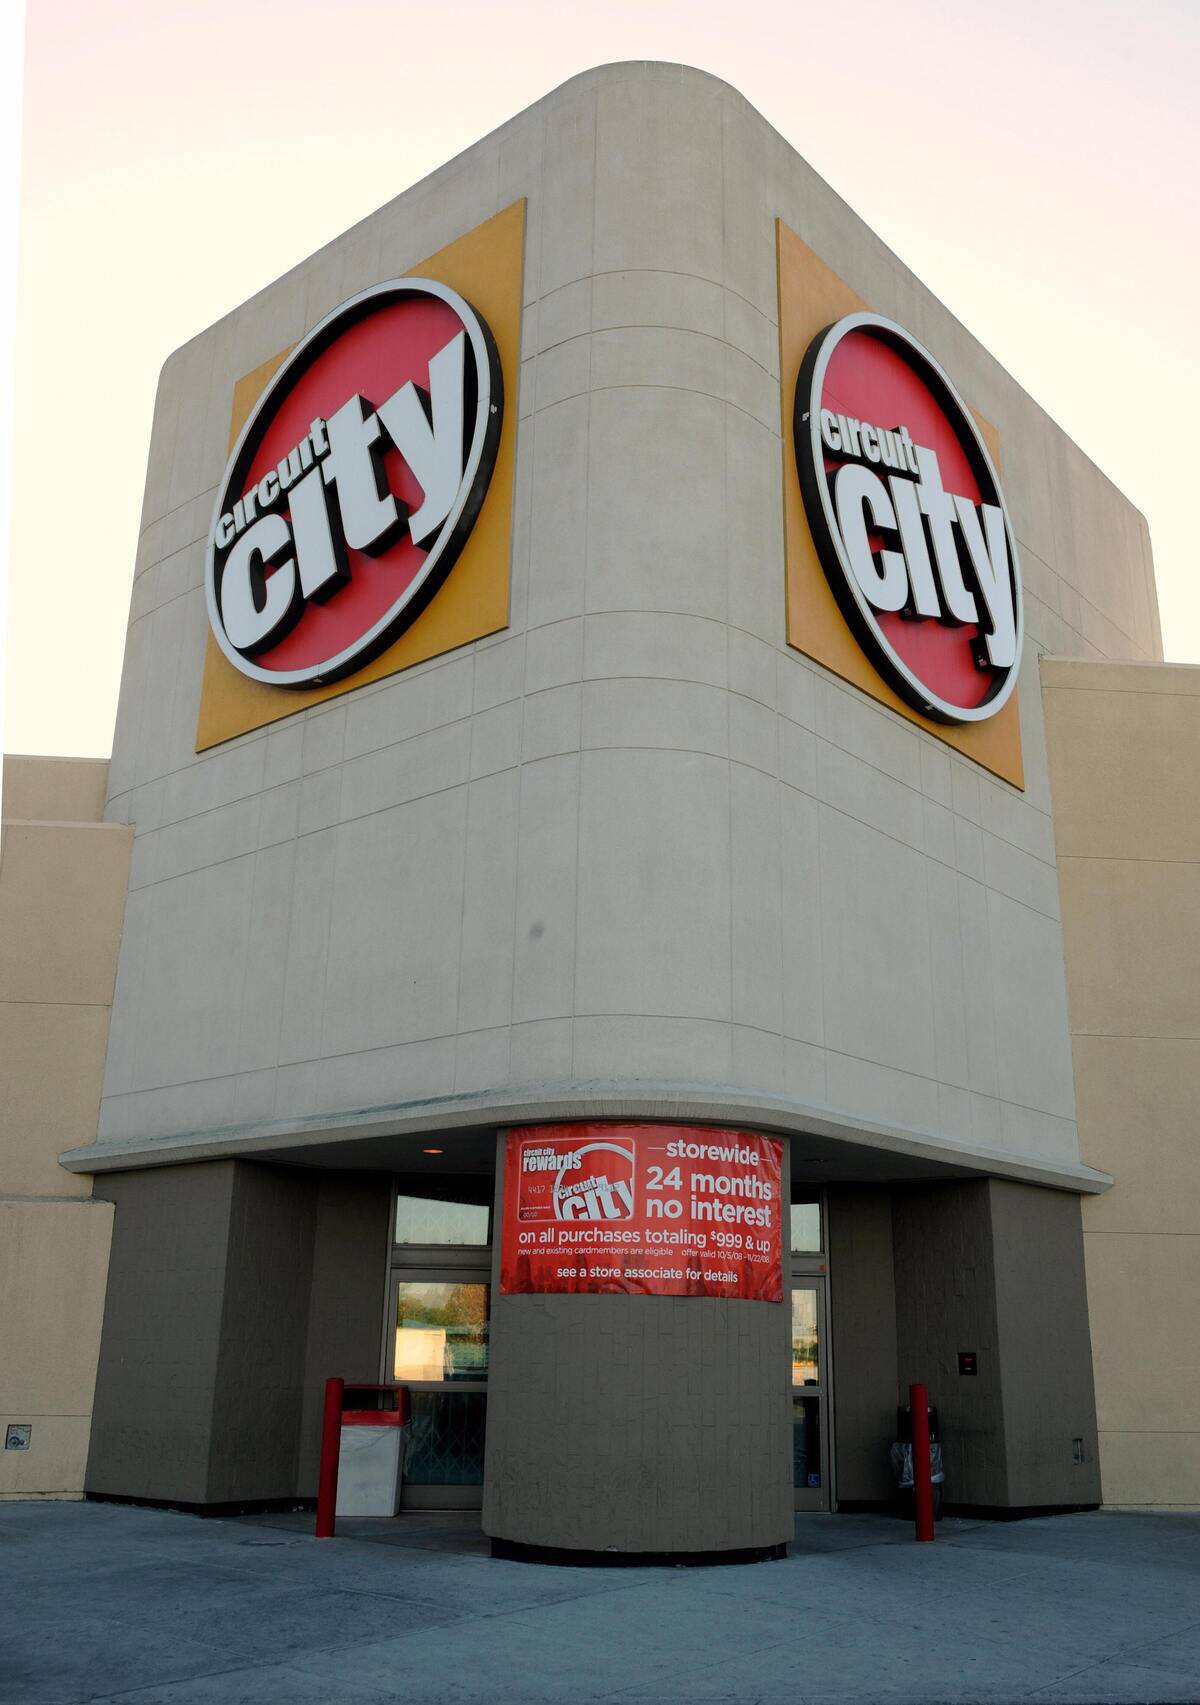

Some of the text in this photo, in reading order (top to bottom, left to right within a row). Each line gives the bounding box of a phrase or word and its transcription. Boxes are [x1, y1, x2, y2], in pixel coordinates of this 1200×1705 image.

[820, 408, 918, 475] circuit
[215, 417, 331, 549] circuit
[221, 330, 466, 648] city
[835, 446, 1017, 668] city
[523, 1151, 582, 1172] rewards
[666, 1139, 759, 1166] storewide
[646, 1165, 772, 1201] 24 months
[646, 1194, 772, 1228] no interest
[518, 1227, 771, 1254] on all purchases totaling $999 & up
[532, 1247, 545, 1255] and
[546, 1246, 573, 1256] existing
[574, 1246, 629, 1255] cardmembers
[630, 1247, 643, 1255] are
[644, 1247, 673, 1256] eligible
[681, 1248, 698, 1257] offer
[700, 1249, 716, 1258] valid
[557, 1266, 738, 1283] see a store associate for details
